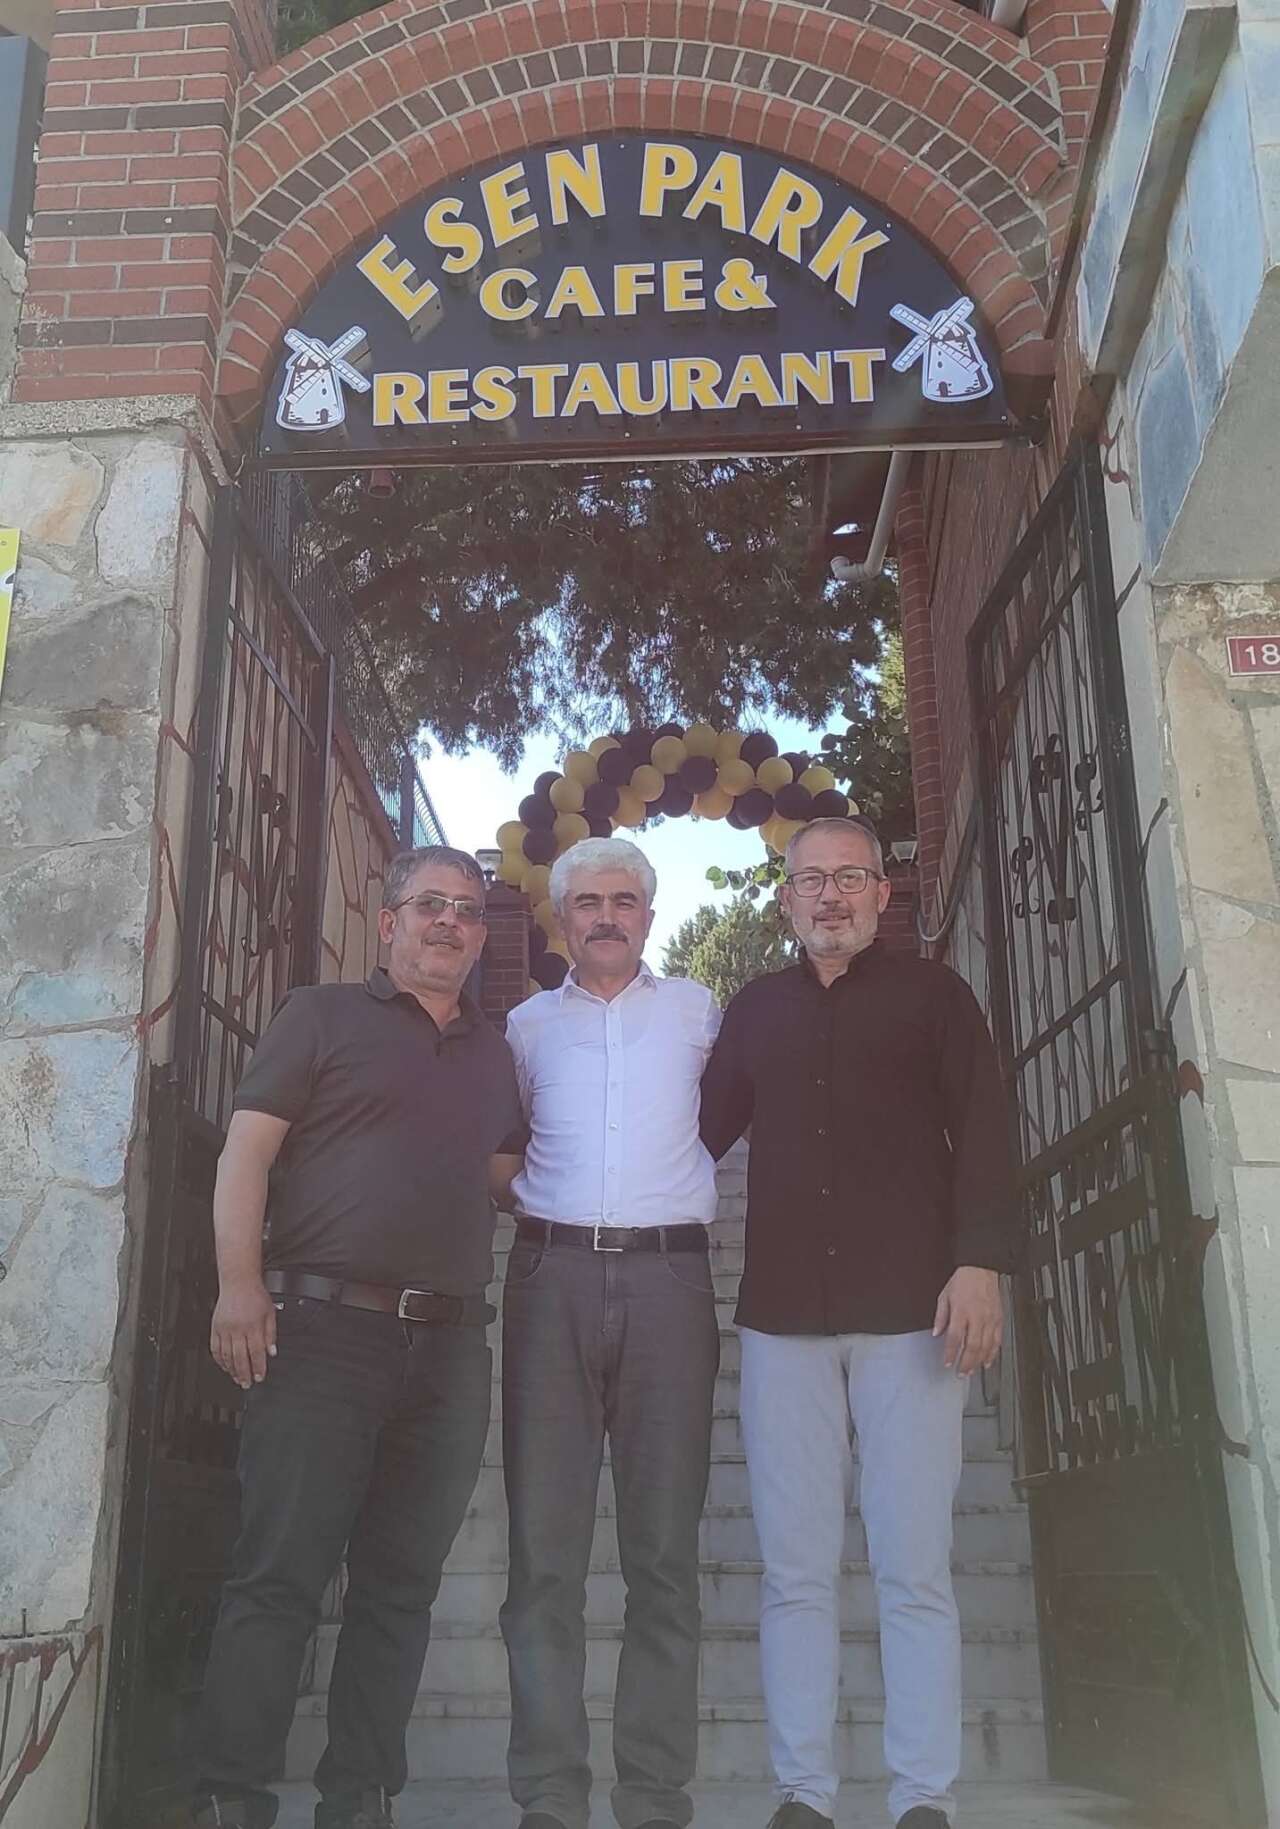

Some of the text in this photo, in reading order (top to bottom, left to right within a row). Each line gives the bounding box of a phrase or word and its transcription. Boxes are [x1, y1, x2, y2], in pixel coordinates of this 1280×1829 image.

[356, 142, 890, 321] ESEN PARK
[372, 348, 885, 426] RESTAURANT
[1244, 643, 1280, 665] 18
